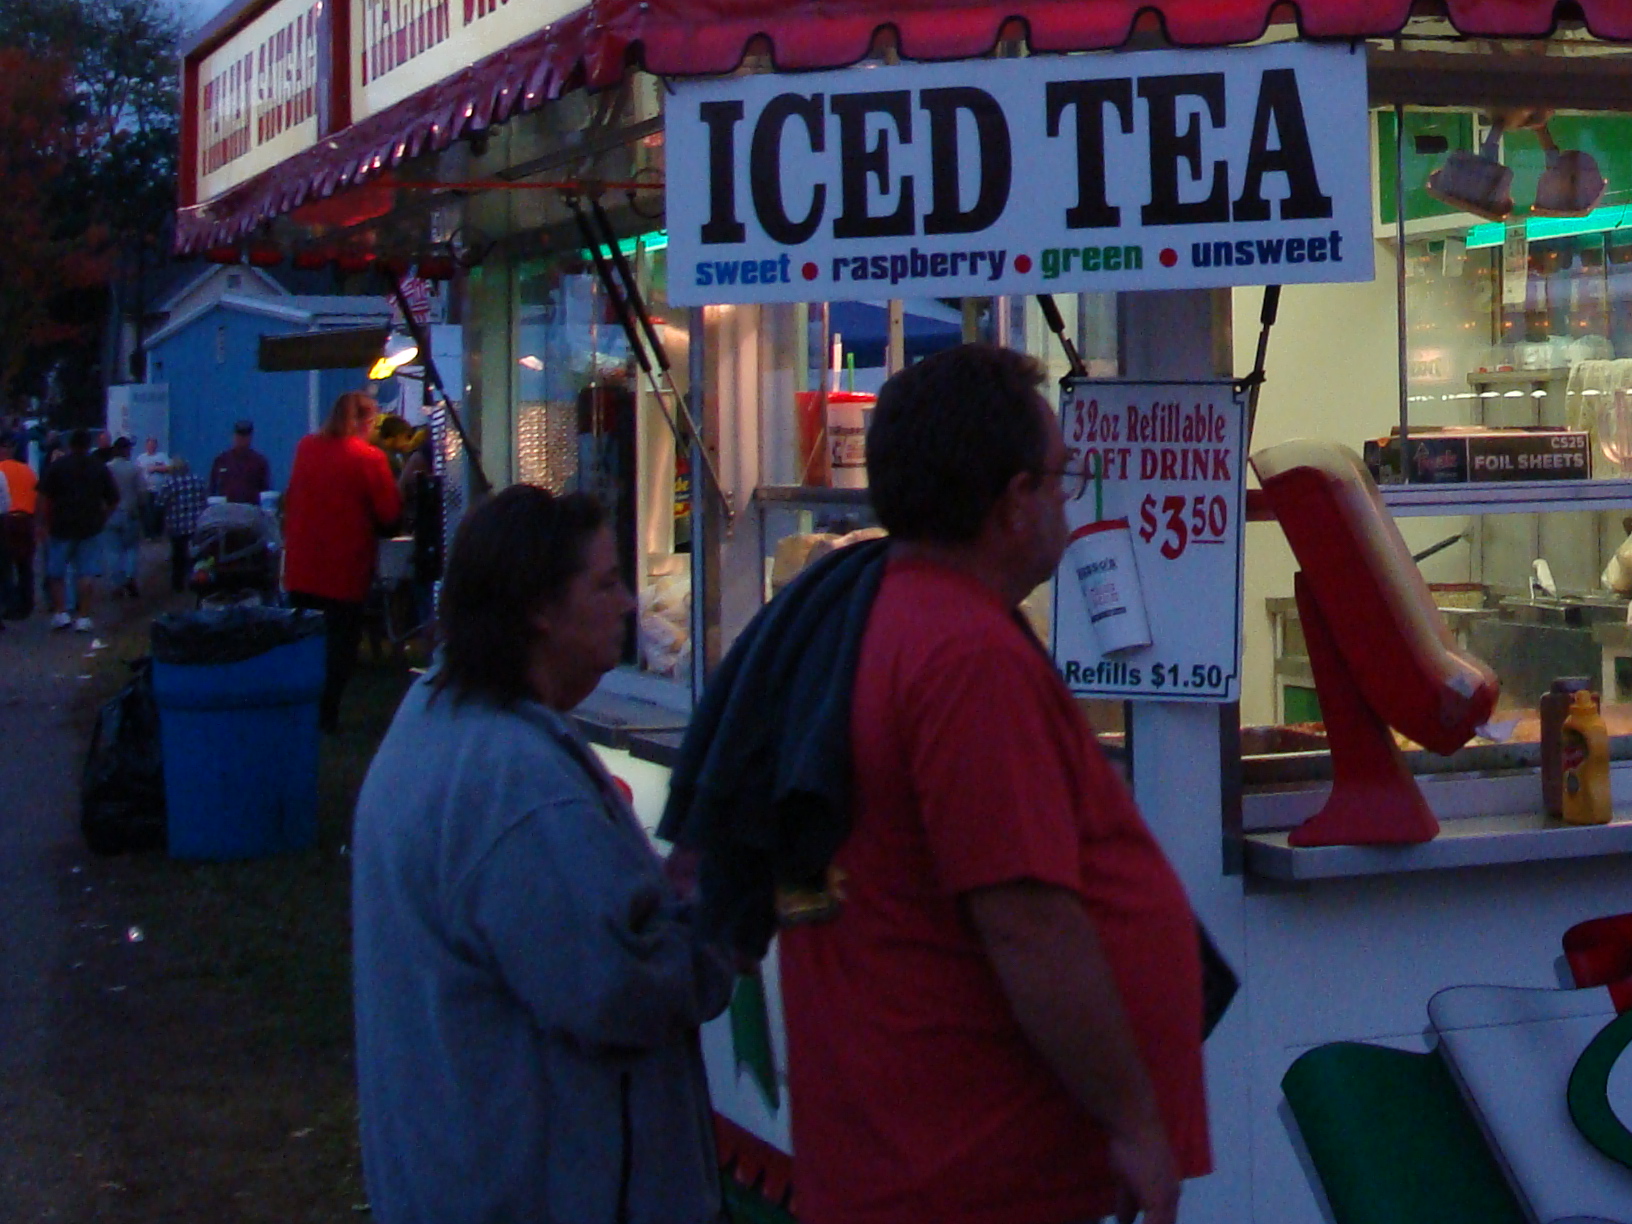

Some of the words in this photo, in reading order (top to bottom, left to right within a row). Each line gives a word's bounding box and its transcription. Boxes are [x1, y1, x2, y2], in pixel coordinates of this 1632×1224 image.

[203, 51, 253, 178] ITALIAN
[257, 4, 318, 146] SAUSAG
[699, 84, 1012, 246] ICED
[1045, 67, 1333, 229] TEA
[695, 253, 792, 287] sweet
[831, 246, 1006, 283] raspberry
[1042, 244, 1144, 279] green
[1190, 231, 1344, 269] unsweet
[1073, 399, 1120, 442] 32oz
[1126, 401, 1227, 444] Refillable
[1474, 455, 1514, 471] FOIL
[1517, 452, 1584, 469] SHEETS
[1551, 436, 1585, 449] CS25
[1140, 447, 1231, 481] DRINK
[1065, 660, 1142, 688] Refills
[1151, 661, 1222, 689] $1.50
